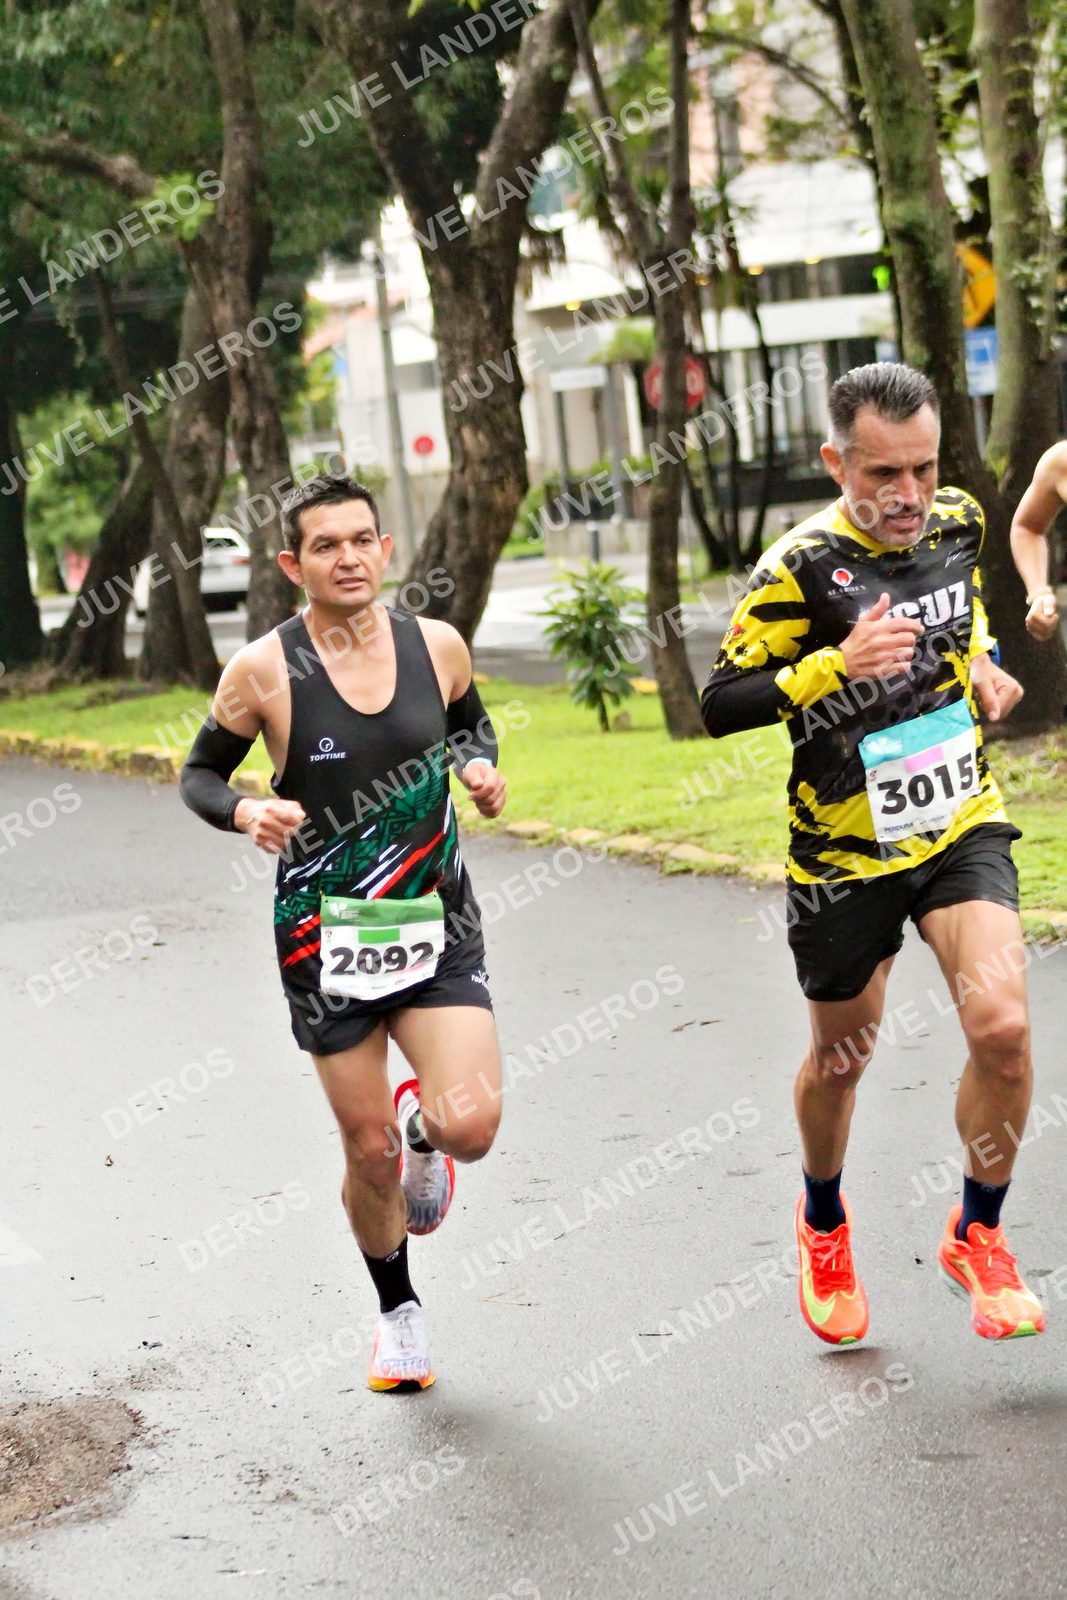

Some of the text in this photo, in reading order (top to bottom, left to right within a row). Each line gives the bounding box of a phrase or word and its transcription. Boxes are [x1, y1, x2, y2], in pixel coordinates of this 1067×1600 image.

[309, 752, 346, 762] TOPTIME
[877, 753, 974, 815] 3015
[329, 942, 434, 976] 2092
